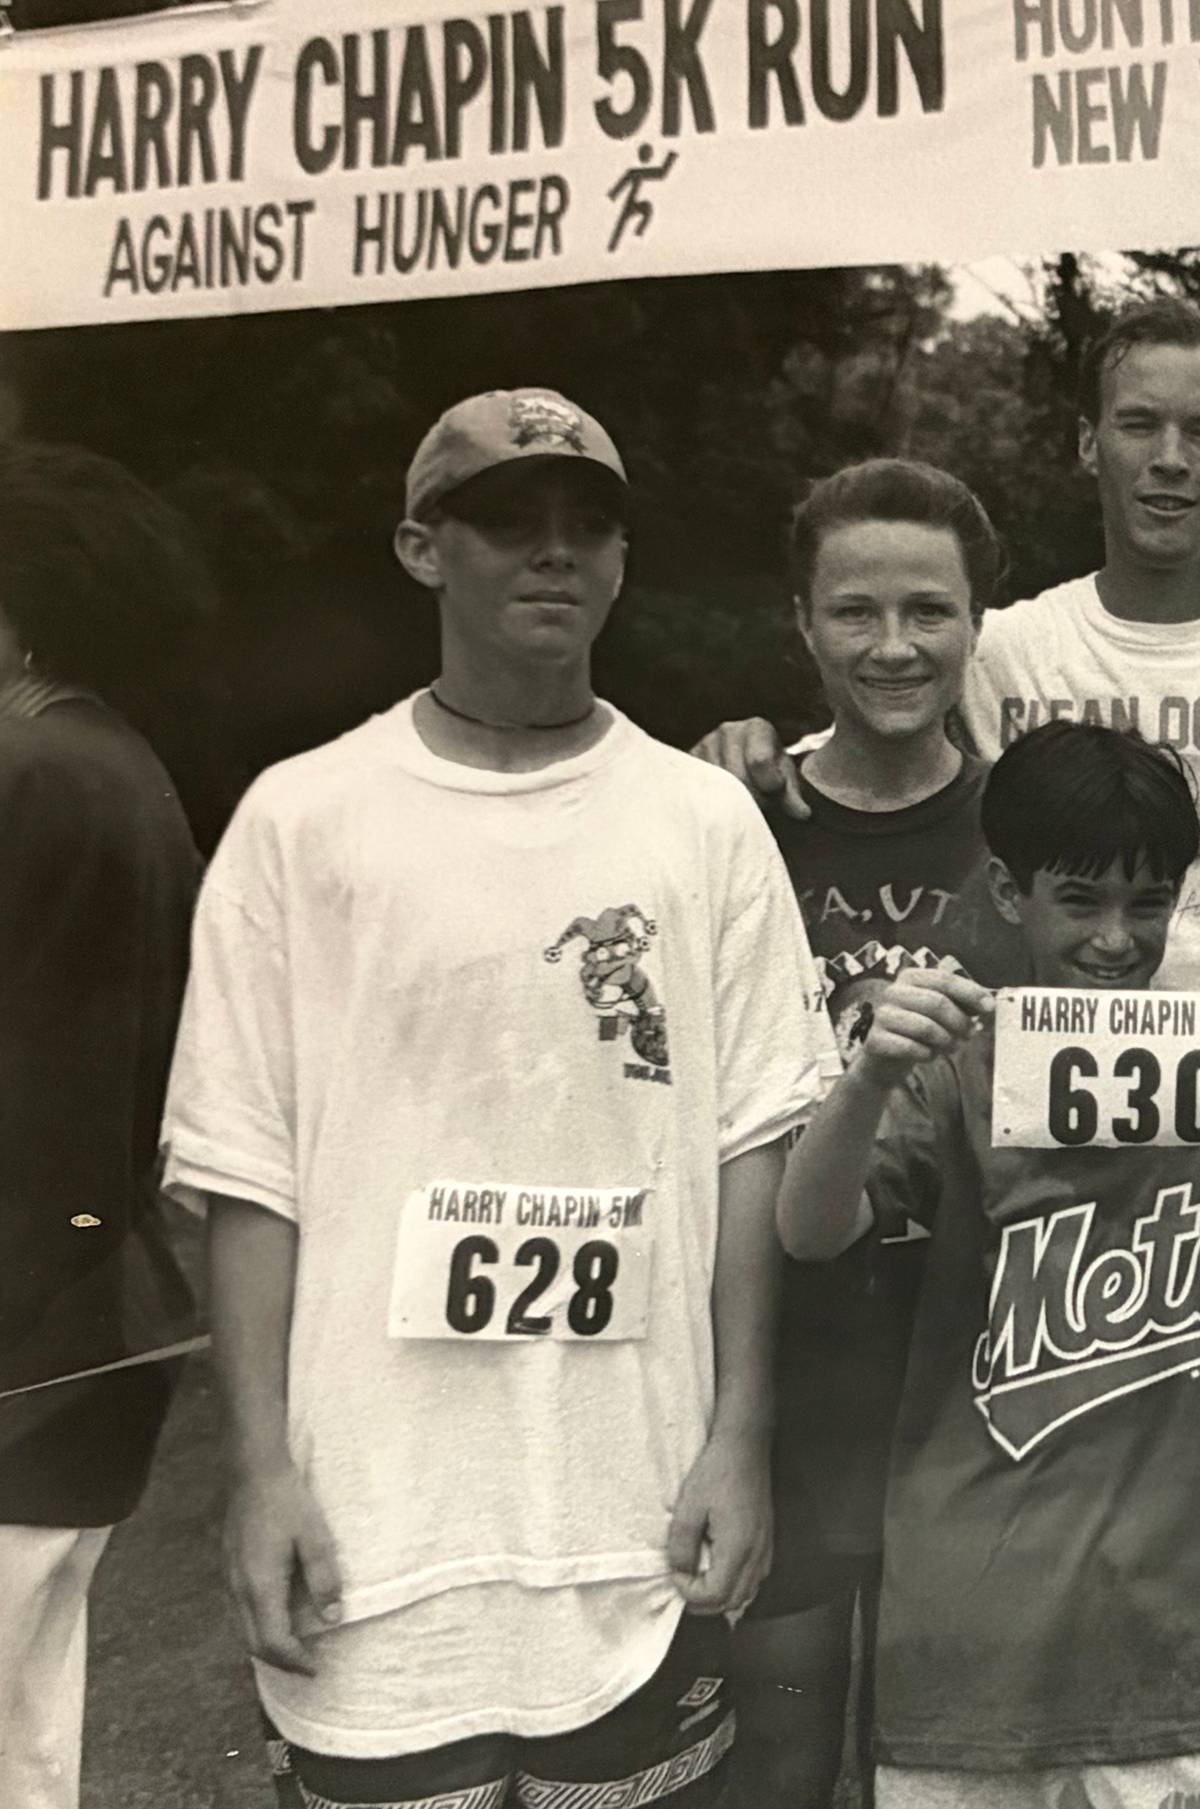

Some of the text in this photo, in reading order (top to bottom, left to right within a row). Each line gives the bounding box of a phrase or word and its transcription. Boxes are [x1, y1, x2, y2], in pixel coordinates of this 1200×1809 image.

[37, 0, 945, 201] HARRY CHAPIN 5K RUN
[1032, 61, 1168, 168] NEW
[103, 174, 570, 298] AGAINST HUNGER
[1021, 998, 1098, 1035] HARRY
[1108, 1001, 1196, 1037] CHAPIN
[427, 1187, 507, 1225] HARRY
[516, 1192, 601, 1228] CHAPIN
[445, 1234, 620, 1337] 628
